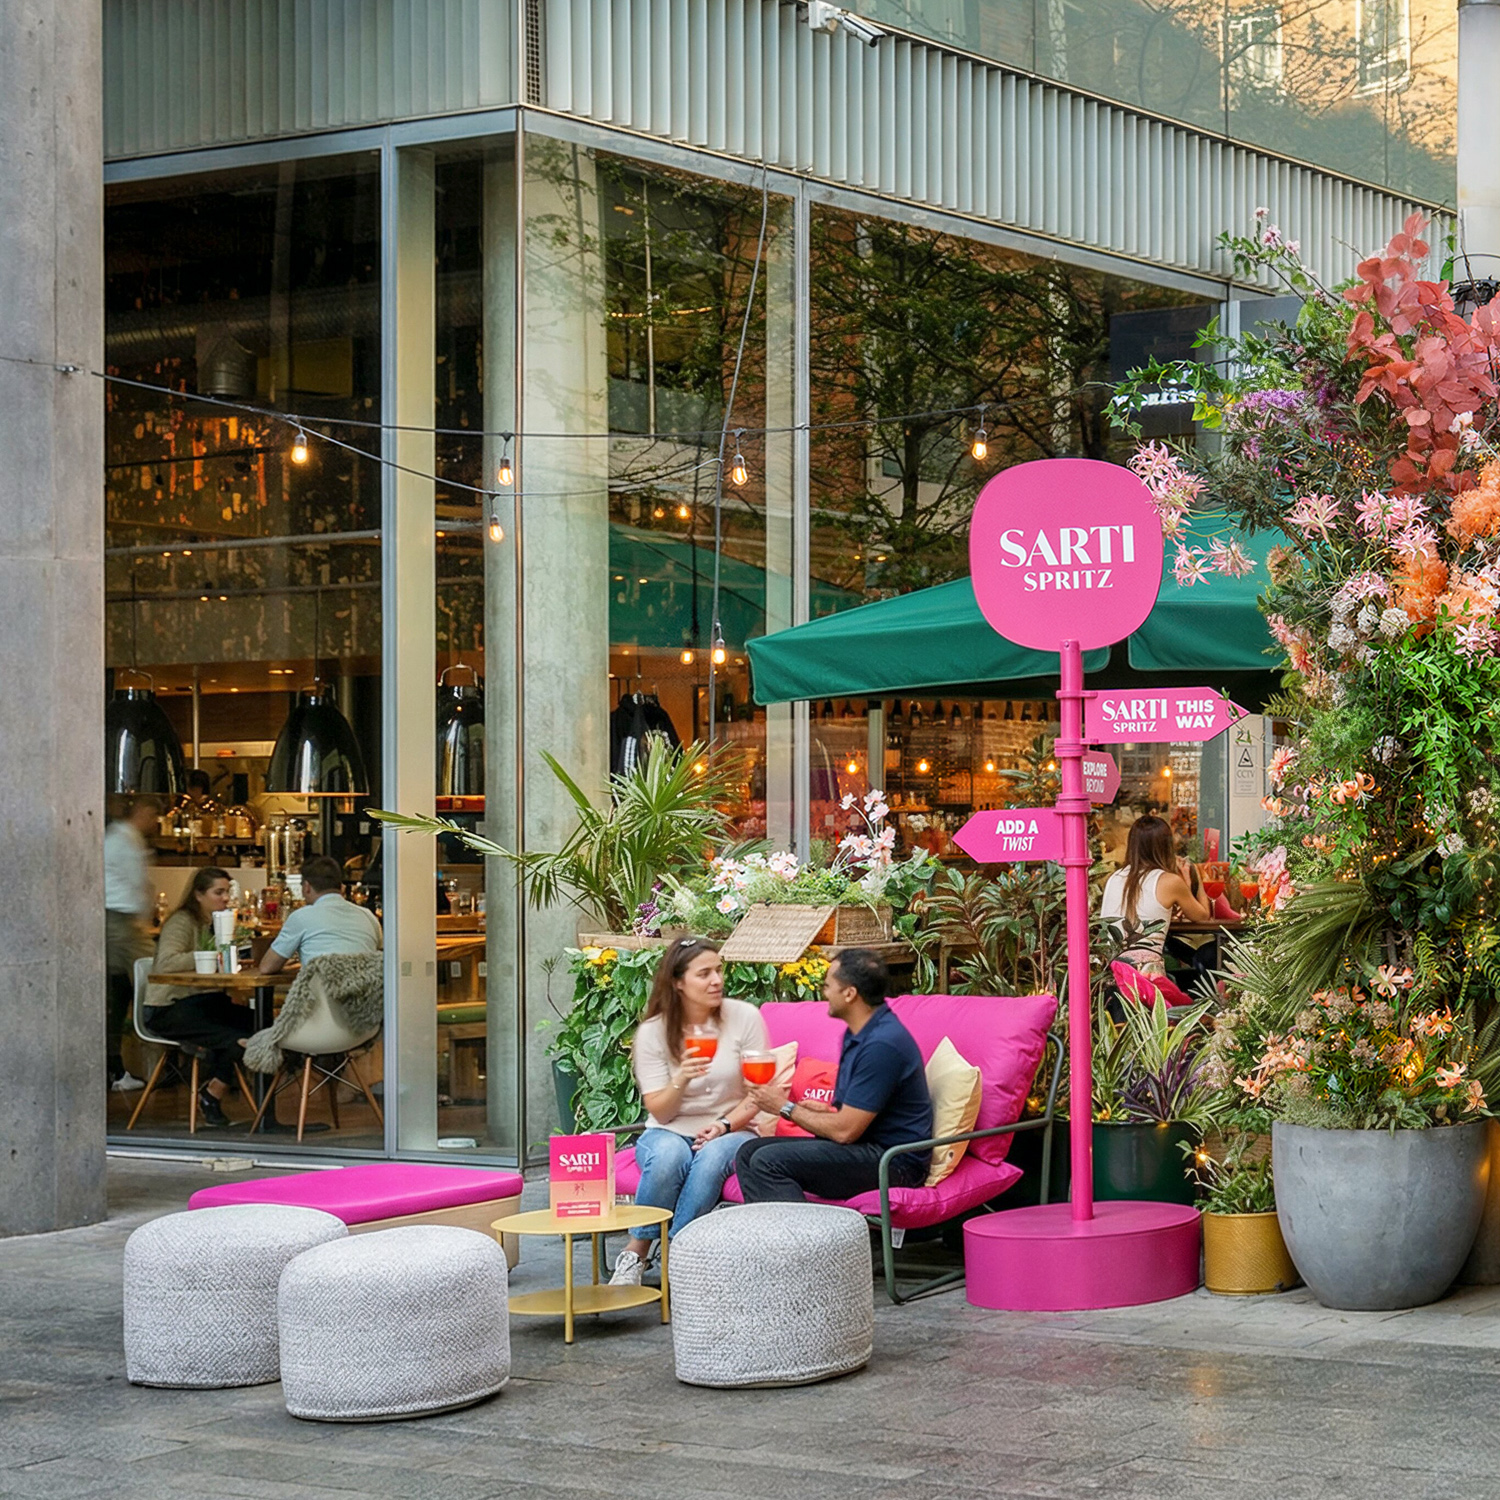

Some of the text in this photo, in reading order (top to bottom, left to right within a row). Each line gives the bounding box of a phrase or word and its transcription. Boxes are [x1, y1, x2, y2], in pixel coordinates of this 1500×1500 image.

[1000, 525, 1135, 568] SARTI
[1023, 569, 1114, 592] SPRITZ
[1102, 699, 1167, 721] SARTI
[1176, 700, 1214, 713] THIS
[1113, 722, 1157, 733] SPRITZ
[1175, 715, 1216, 729] WAY
[1083, 761, 1107, 777] EXPLORE
[1236, 770, 1255, 778] CCTV
[1086, 778, 1105, 793] BEYOND
[995, 820, 1039, 834] ADD A
[1003, 836, 1035, 851] TWIST
[559, 1152, 600, 1167] SARTI
